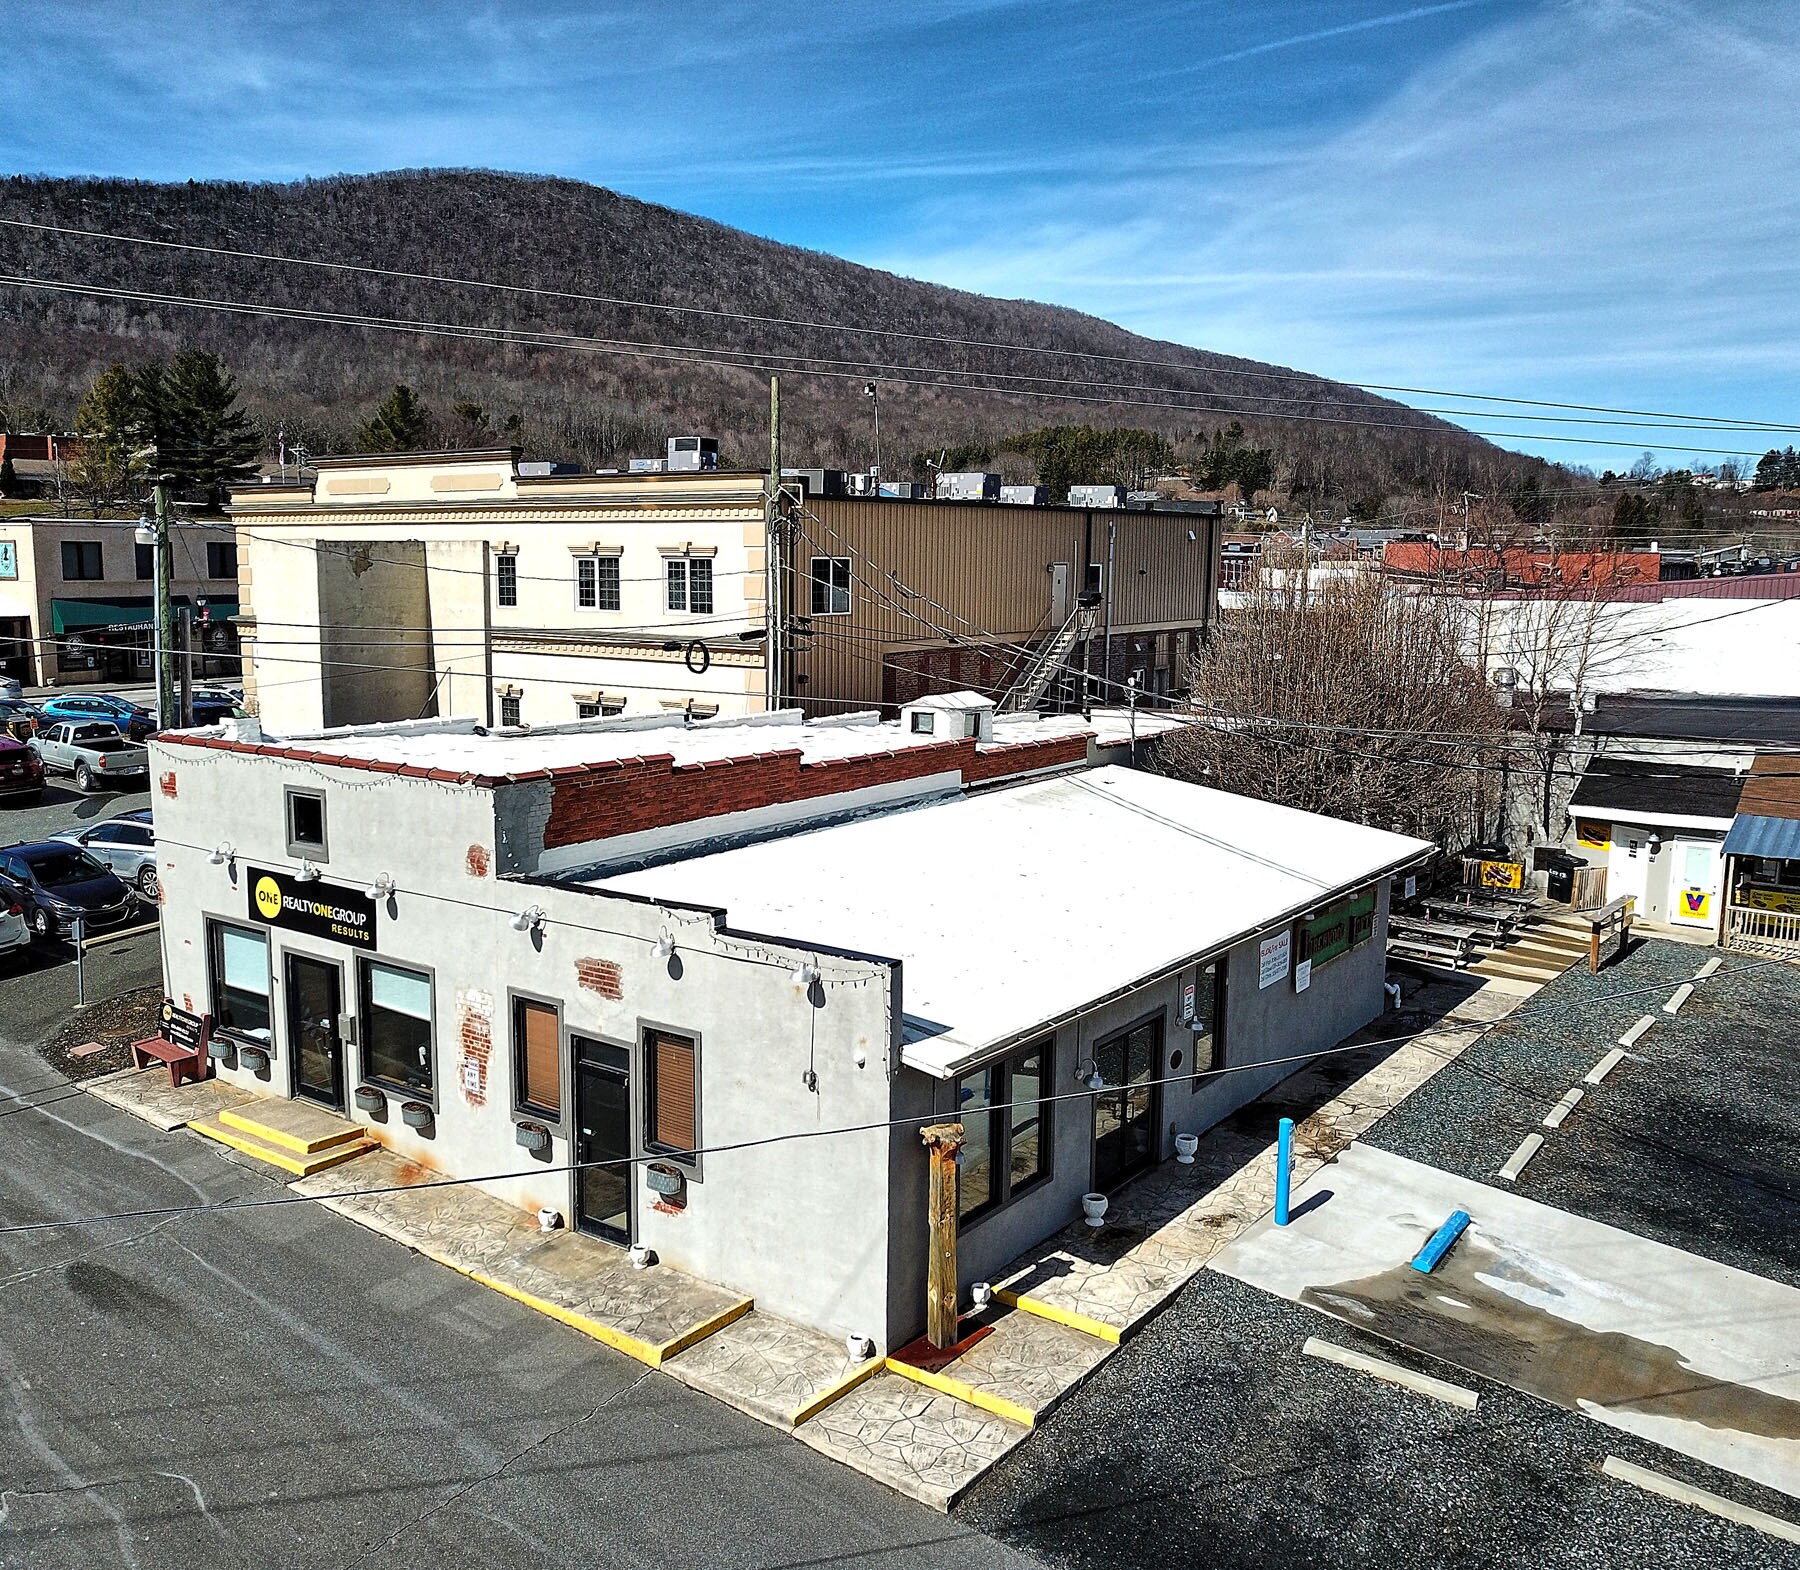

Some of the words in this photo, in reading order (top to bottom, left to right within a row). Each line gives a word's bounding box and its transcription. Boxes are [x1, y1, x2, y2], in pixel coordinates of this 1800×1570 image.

[109, 623, 154, 631] RESTAURAN
[258, 891, 278, 904] ONE
[283, 896, 366, 925] REALTYONEGROUP
[331, 924, 369, 940] RESULTS
